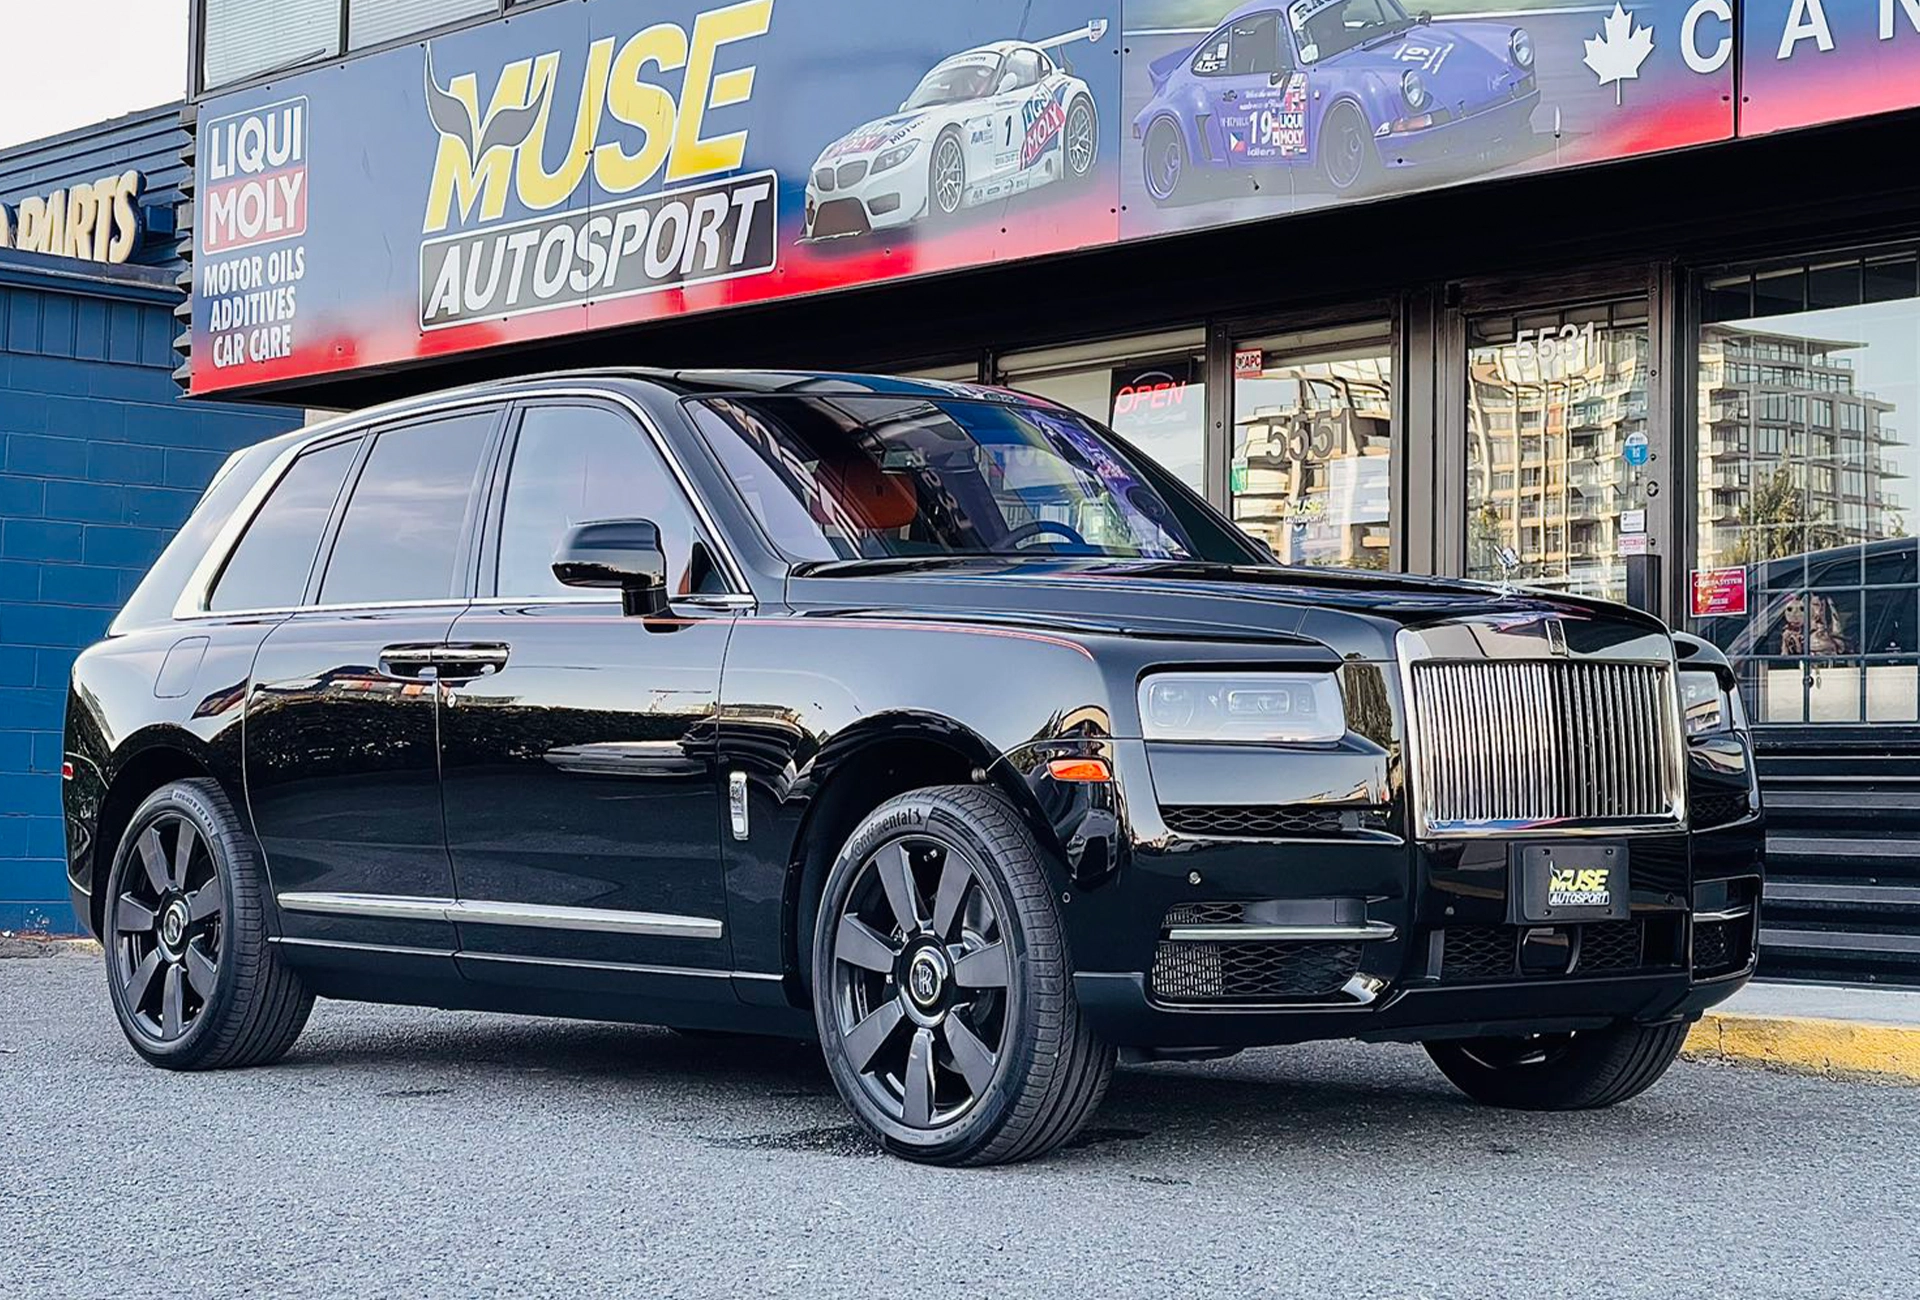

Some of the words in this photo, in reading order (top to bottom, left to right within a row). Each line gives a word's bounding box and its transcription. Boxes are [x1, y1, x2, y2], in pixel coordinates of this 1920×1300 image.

[422, 0, 773, 233] MUSE
[1005, 115, 1012, 147] 1
[1027, 103, 1062, 160] MOLY
[1250, 110, 1272, 144] 19
[1280, 129, 1304, 145] MOLY
[209, 107, 302, 182] LIQUI
[15, 170, 142, 264] PARTS
[208, 172, 304, 246] MOLY
[202, 254, 263, 298] MOTOR
[267, 246, 305, 283] OILS
[424, 183, 770, 320] AUTOSPORT
[210, 287, 296, 333] ADDITIVES
[212, 334, 245, 369] CAR
[249, 325, 292, 362] CARE
[1516, 322, 1595, 371] 5531
[1115, 381, 1186, 414] OPEN
[1265, 408, 1349, 465] 5551
[1549, 864, 1609, 891] MUSE
[1550, 892, 1608, 904] AUTOSPORT
